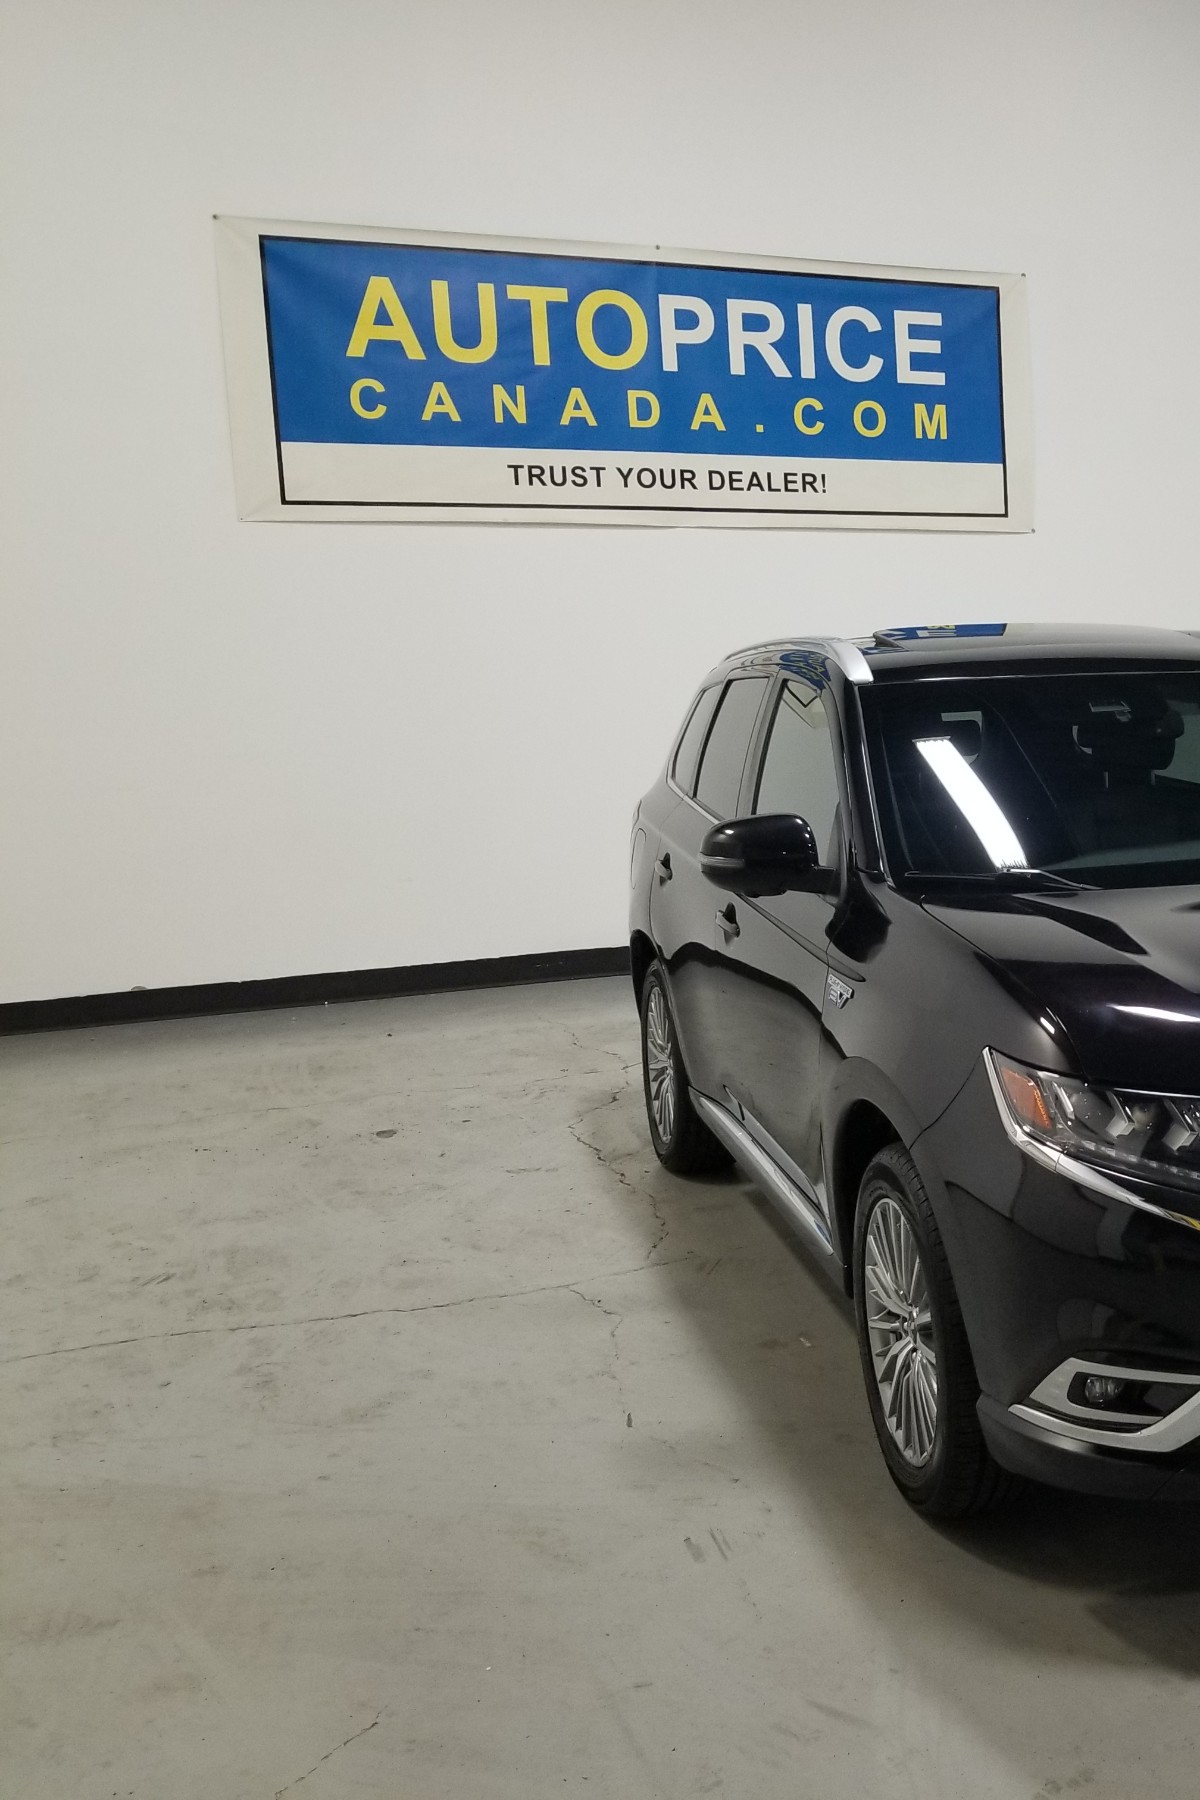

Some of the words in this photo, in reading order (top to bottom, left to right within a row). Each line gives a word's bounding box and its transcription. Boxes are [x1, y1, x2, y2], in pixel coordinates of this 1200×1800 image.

[345, 275, 947, 386] AUTOPRICE
[349, 378, 949, 441] CANADA.COM
[506, 464, 606, 488] TRUST
[616, 467, 698, 490] YOUR
[707, 469, 827, 494] DEALER!
